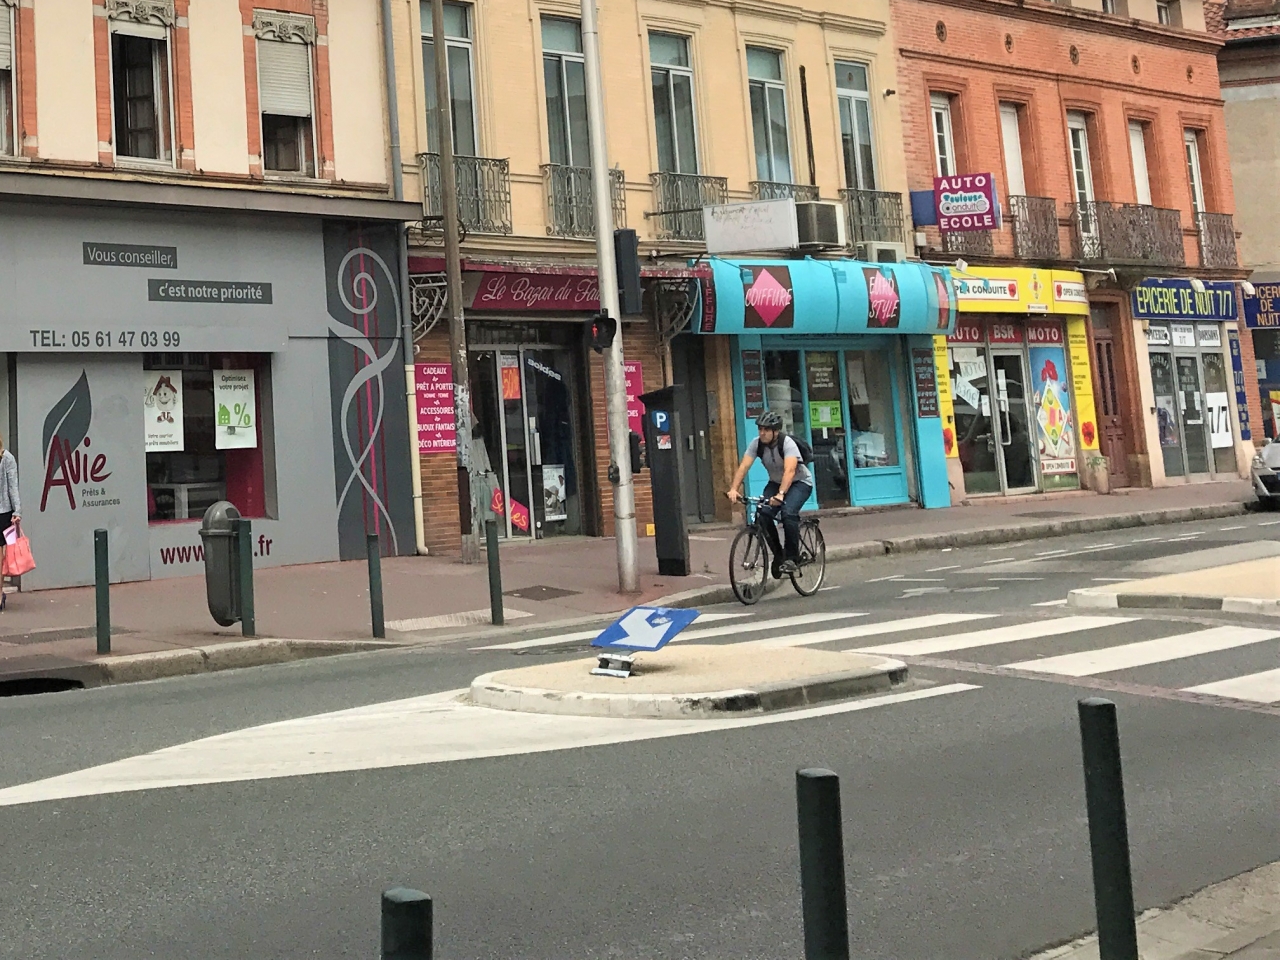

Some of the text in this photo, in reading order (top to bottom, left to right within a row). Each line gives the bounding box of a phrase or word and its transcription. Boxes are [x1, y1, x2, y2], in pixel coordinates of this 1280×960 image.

[940, 176, 986, 190] AUTO
[943, 194, 983, 203] Toulouse
[940, 215, 993, 229] ECOLE
[87, 246, 174, 267] Vous conseiller,
[188, 285, 218, 298] notre
[220, 286, 263, 302] priorité
[482, 275, 601, 306] Le Bazar du Fau
[954, 285, 1007, 294] PEN CONDUITE
[700, 263, 715, 331] CIFFURE
[745, 288, 793, 307] COIFFURE
[1136, 286, 1232, 317] EPICERIE DE NUIT 7/7
[869, 299, 900, 319] STYLE
[1260, 299, 1274, 312] DE
[1256, 313, 1280, 326] NUIT
[30, 329, 181, 348] TEL: 05 61 47 03 99
[993, 325, 1015, 339] BSR
[1028, 327, 1059, 341] MOTO
[422, 367, 447, 375] CADEAUX
[416, 381, 429, 391] PRÊT
[420, 407, 455, 415] ACCESSOIRES
[656, 412, 667, 429] P
[40, 434, 114, 513] Avie
[81, 487, 106, 497] Prêts &
[81, 498, 121, 508] Assurances
[160, 535, 273, 565] www.fr
